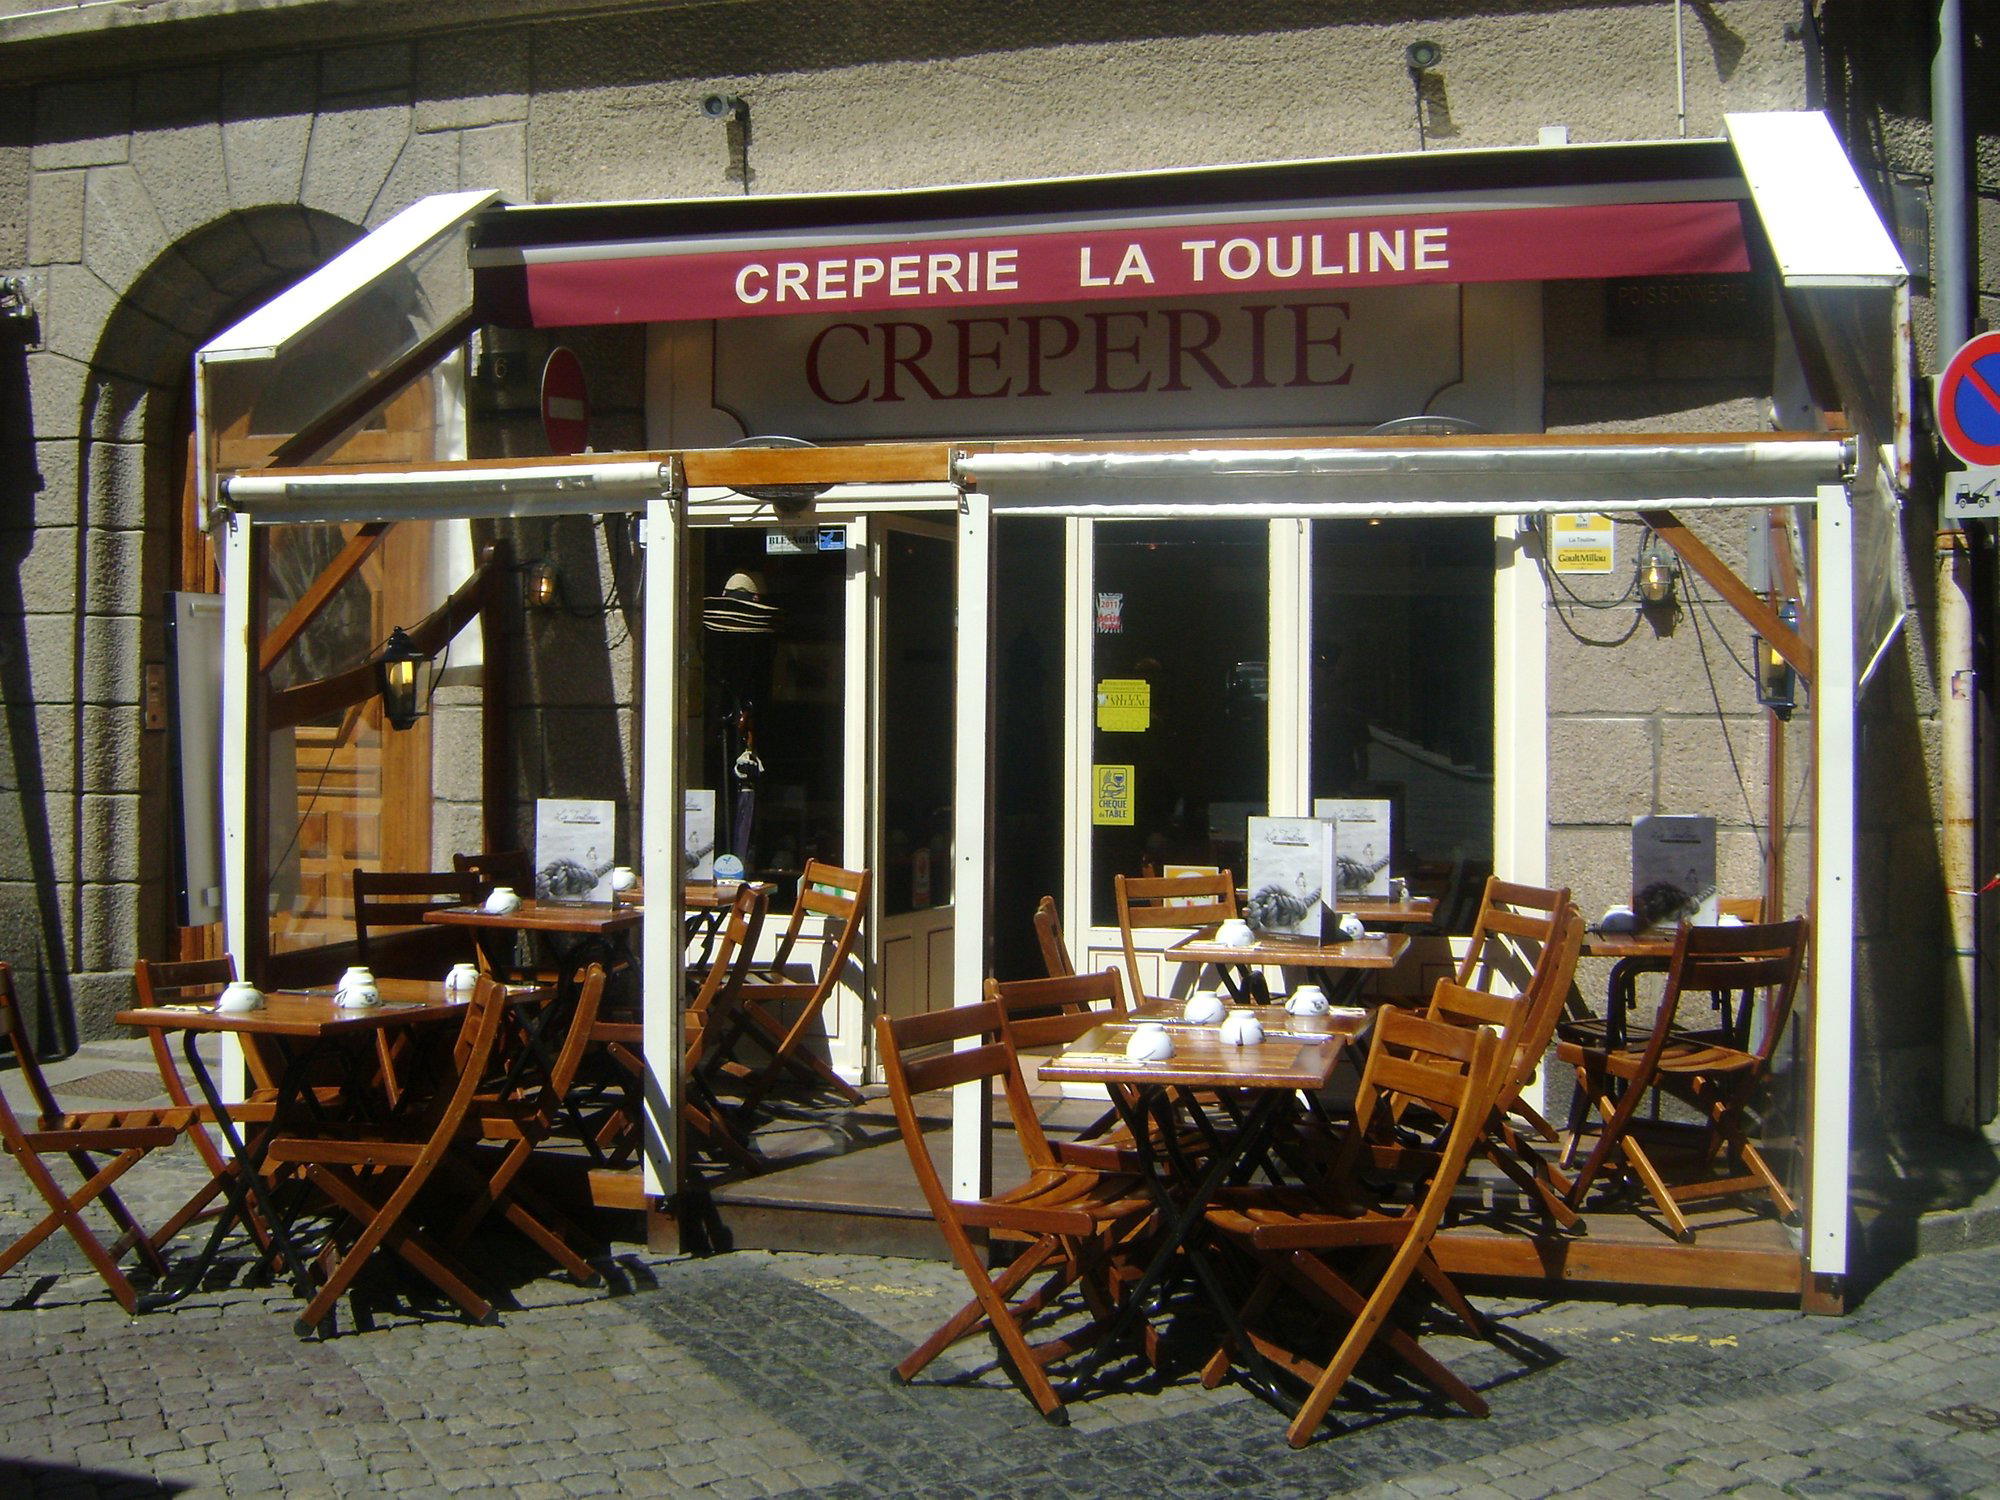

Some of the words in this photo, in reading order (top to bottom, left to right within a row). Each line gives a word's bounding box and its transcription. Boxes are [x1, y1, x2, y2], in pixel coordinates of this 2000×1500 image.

[734, 248, 1019, 304] CREPERIE
[1080, 244, 1155, 287] LA
[1181, 227, 1450, 282] TOULINE
[805, 301, 1353, 405] CREPERIE
[1105, 809, 1127, 818] TABLE
